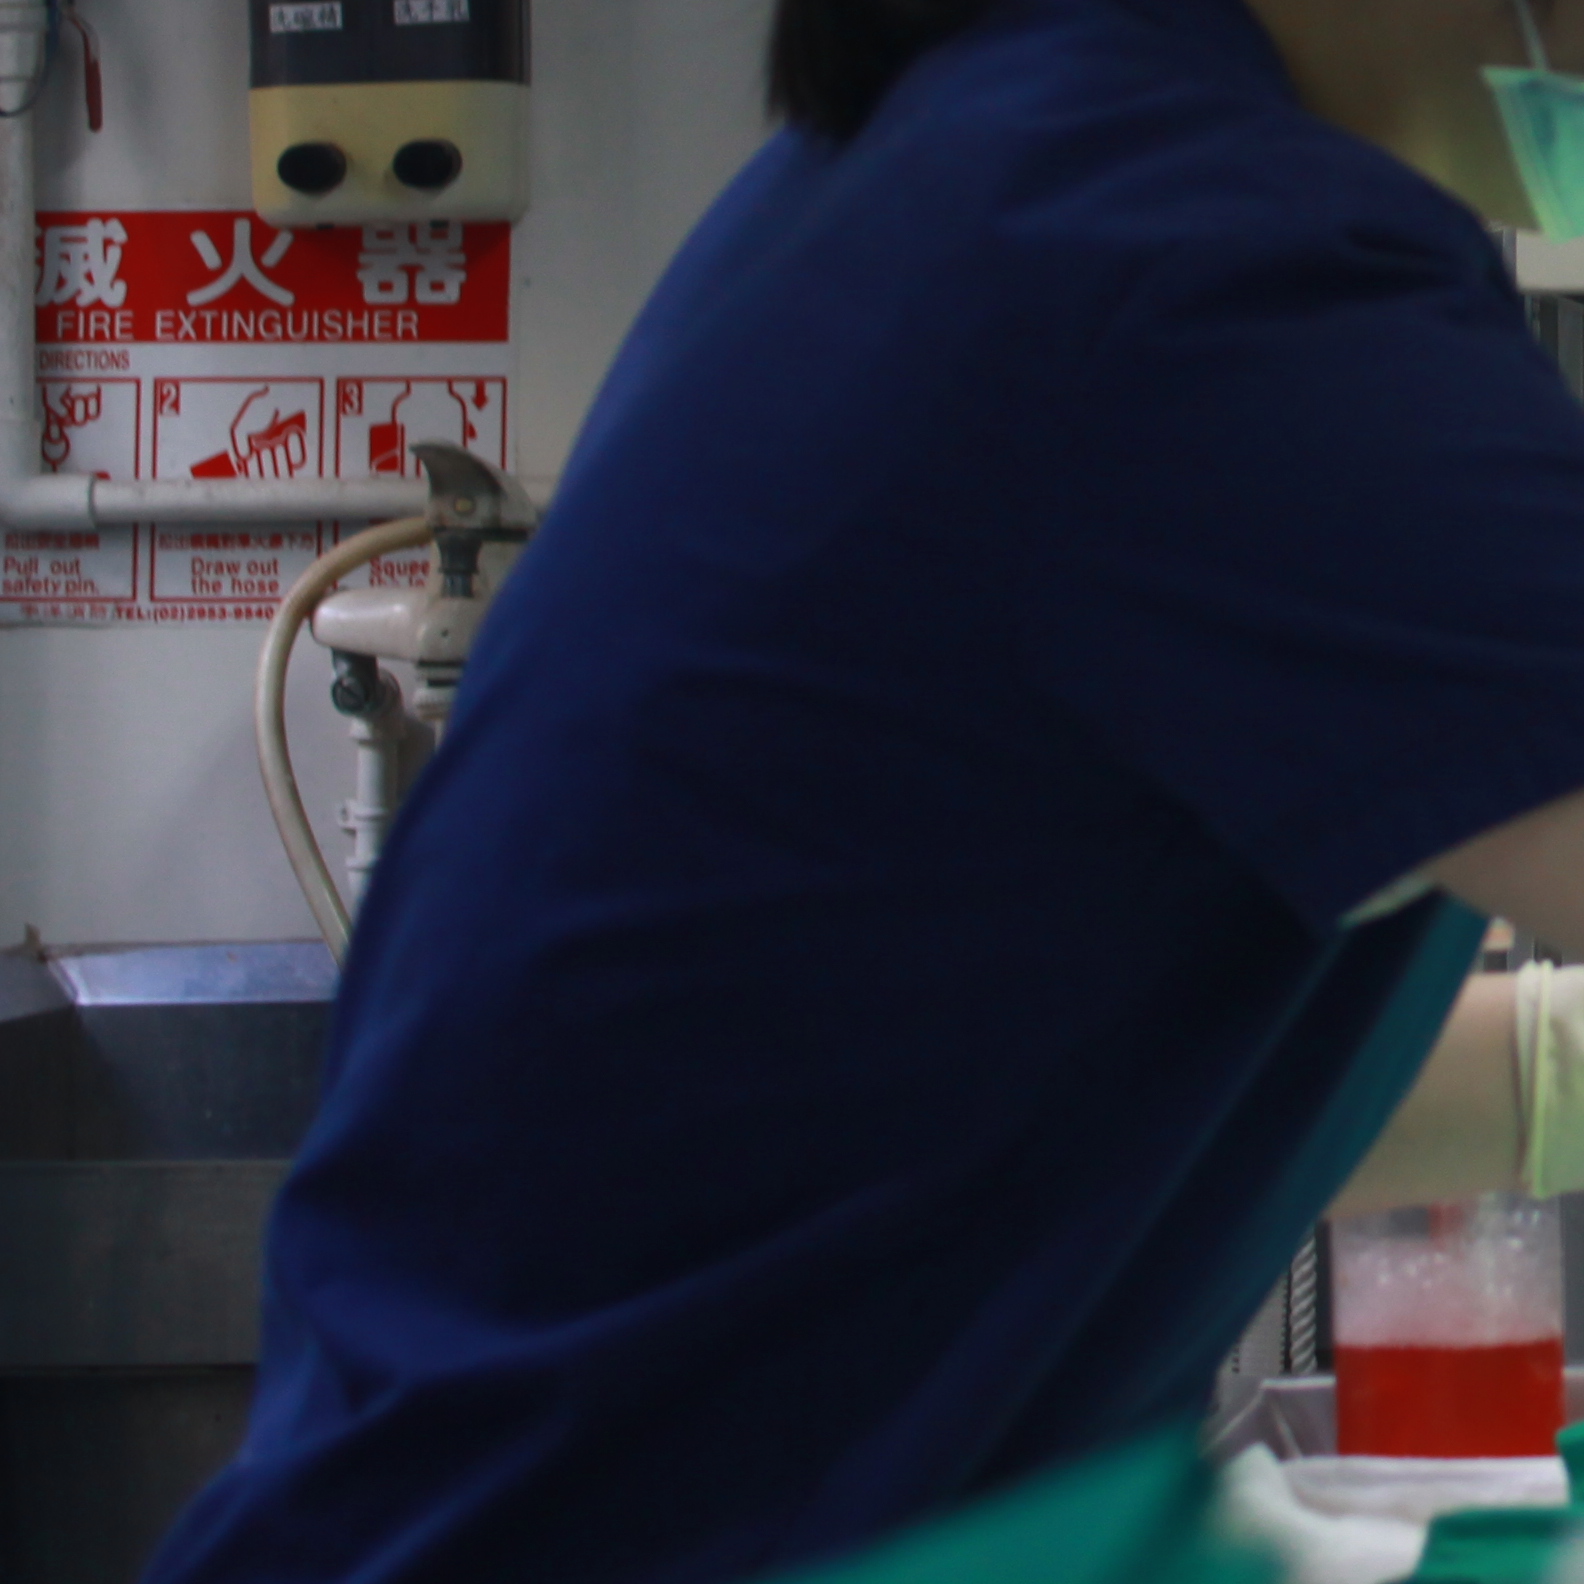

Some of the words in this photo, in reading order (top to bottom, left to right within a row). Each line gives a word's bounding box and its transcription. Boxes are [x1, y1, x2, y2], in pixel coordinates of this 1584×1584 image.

[35, 217, 467, 308] 滅火器
[57, 310, 134, 341] FIRE
[155, 310, 419, 341] EXTINGUISHER
[39, 349, 131, 371] DIRECTIONS
[161, 381, 178, 414] 2
[343, 382, 362, 414] 3
[4, 556, 38, 576] Pull
[50, 557, 80, 576] out
[192, 557, 240, 576] Draw
[248, 557, 279, 576] out
[369, 557, 431, 579] Squee
[2, 576, 62, 596] safety
[191, 576, 223, 594] the
[231, 576, 279, 594] hose
